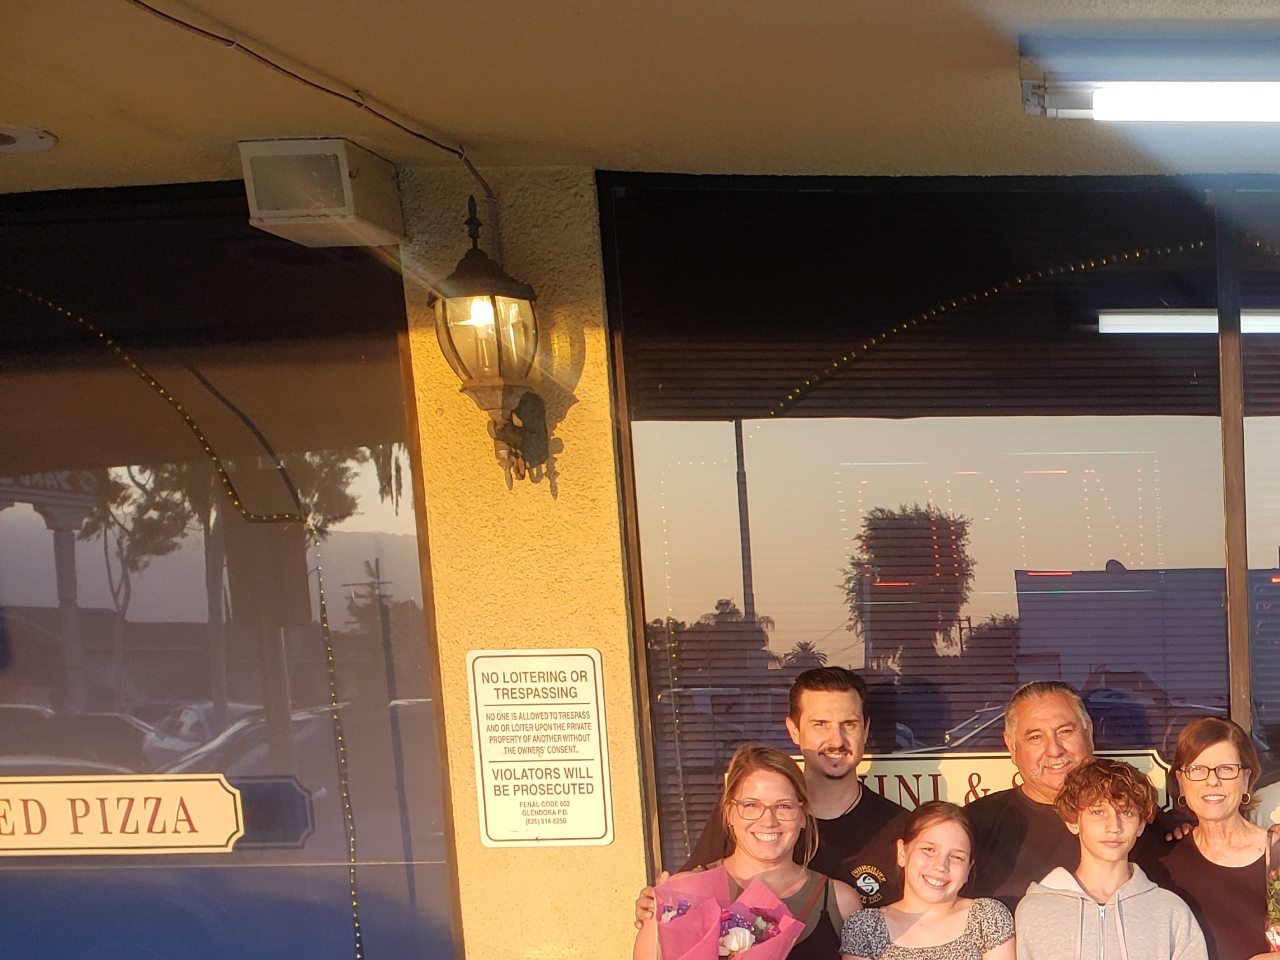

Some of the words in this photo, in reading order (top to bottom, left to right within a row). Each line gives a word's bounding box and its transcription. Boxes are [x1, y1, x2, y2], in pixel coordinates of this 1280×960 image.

[481, 672, 499, 684] NO
[502, 670, 567, 684] LOITERING
[570, 670, 589, 682] OR
[493, 686, 578, 700] TRESPASSING
[485, 712, 496, 721] NO
[496, 712, 510, 721] ONE
[511, 712, 518, 720] IS
[518, 711, 549, 720] ALLOWED
[550, 711, 558, 720] TO
[559, 710, 591, 720] TRESPASS
[486, 724, 500, 733] AND
[500, 724, 510, 732] OR
[511, 723, 534, 732] LOITER
[534, 723, 553, 732] UPON
[553, 722, 566, 731] THE
[566, 722, 592, 731] PRIVATE
[489, 735, 522, 744] PROPERTY
[522, 734, 532, 744] OF
[532, 734, 562, 743] ANOTHER
[562, 734, 591, 742] WITHOUT
[504, 746, 517, 755] THE
[517, 746, 546, 755] OWNERS'
[492, 767, 561, 781] VIOLATORS
[563, 766, 594, 780] WILL
[494, 784, 510, 796] BE
[513, 782, 594, 796] PROSECUTED
[540, 800, 558, 808] CODE
[66, 796, 199, 835] PIZZA
